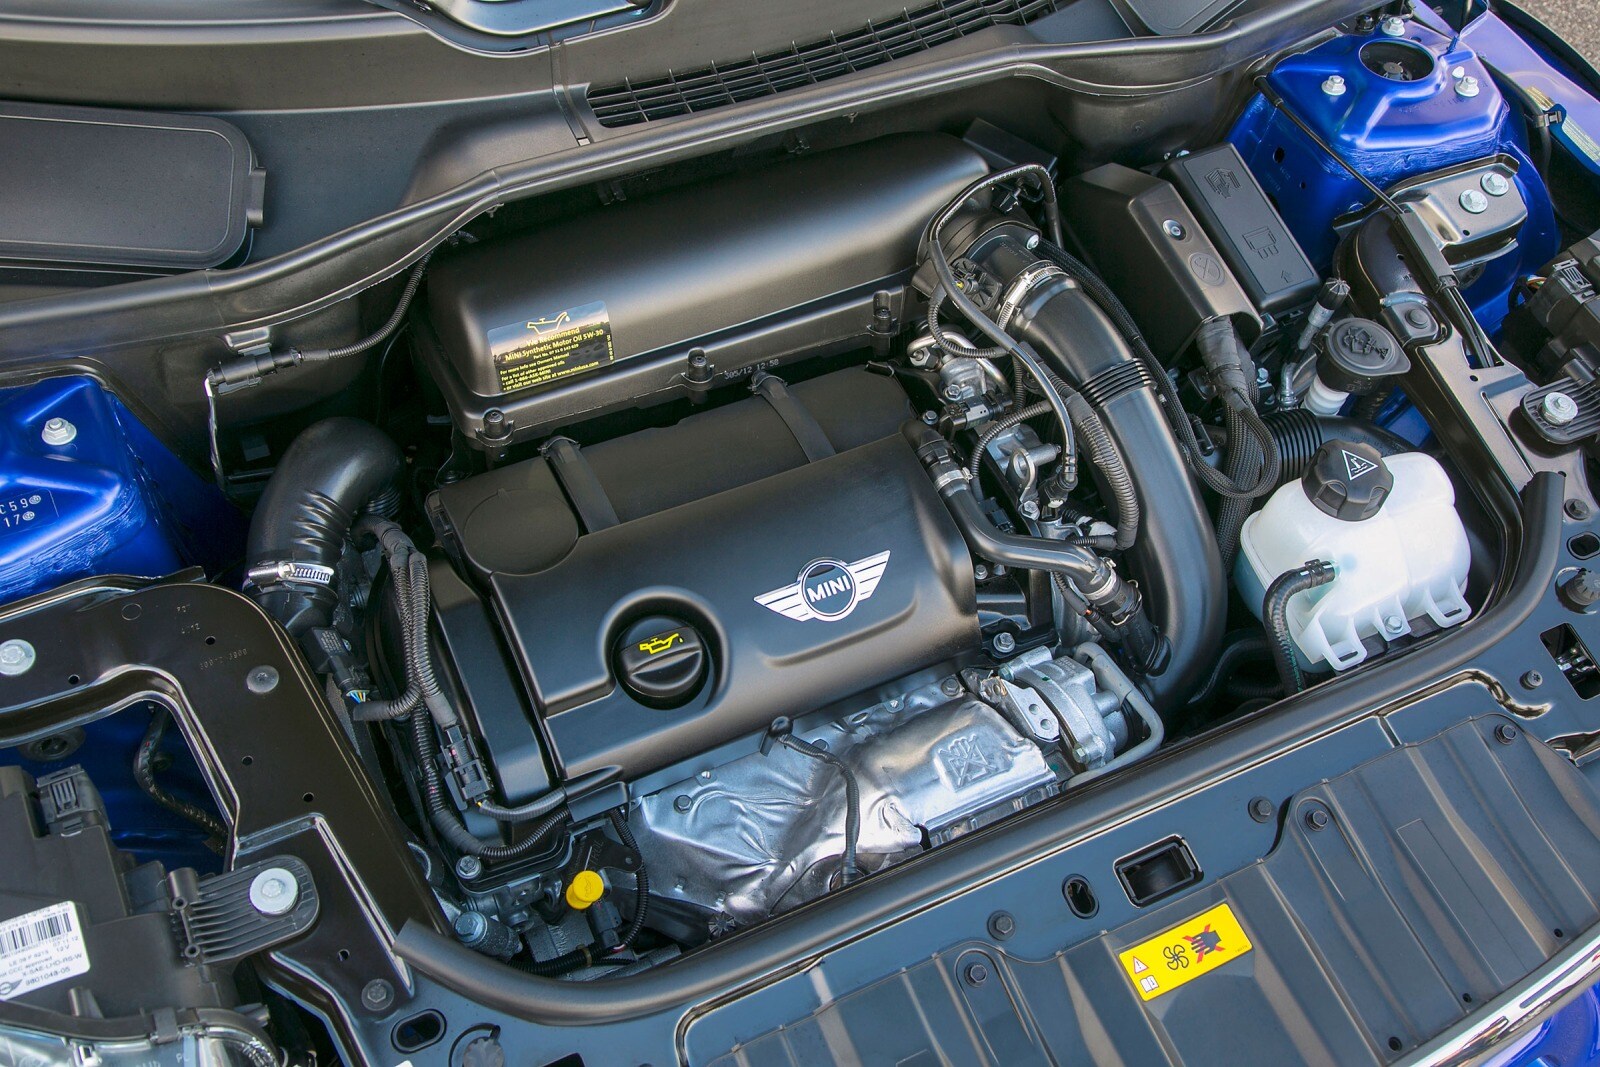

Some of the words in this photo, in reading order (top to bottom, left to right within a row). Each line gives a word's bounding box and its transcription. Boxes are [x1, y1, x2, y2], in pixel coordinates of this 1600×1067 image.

[505, 351, 522, 361] MINI
[522, 343, 552, 357] Synthetic
[552, 338, 572, 348] Motor
[583, 329, 604, 340] 5W-30
[526, 339, 538, 347] We
[538, 327, 580, 343] Recommend
[553, 352, 570, 360] Manual
[806, 574, 851, 603] MINI
